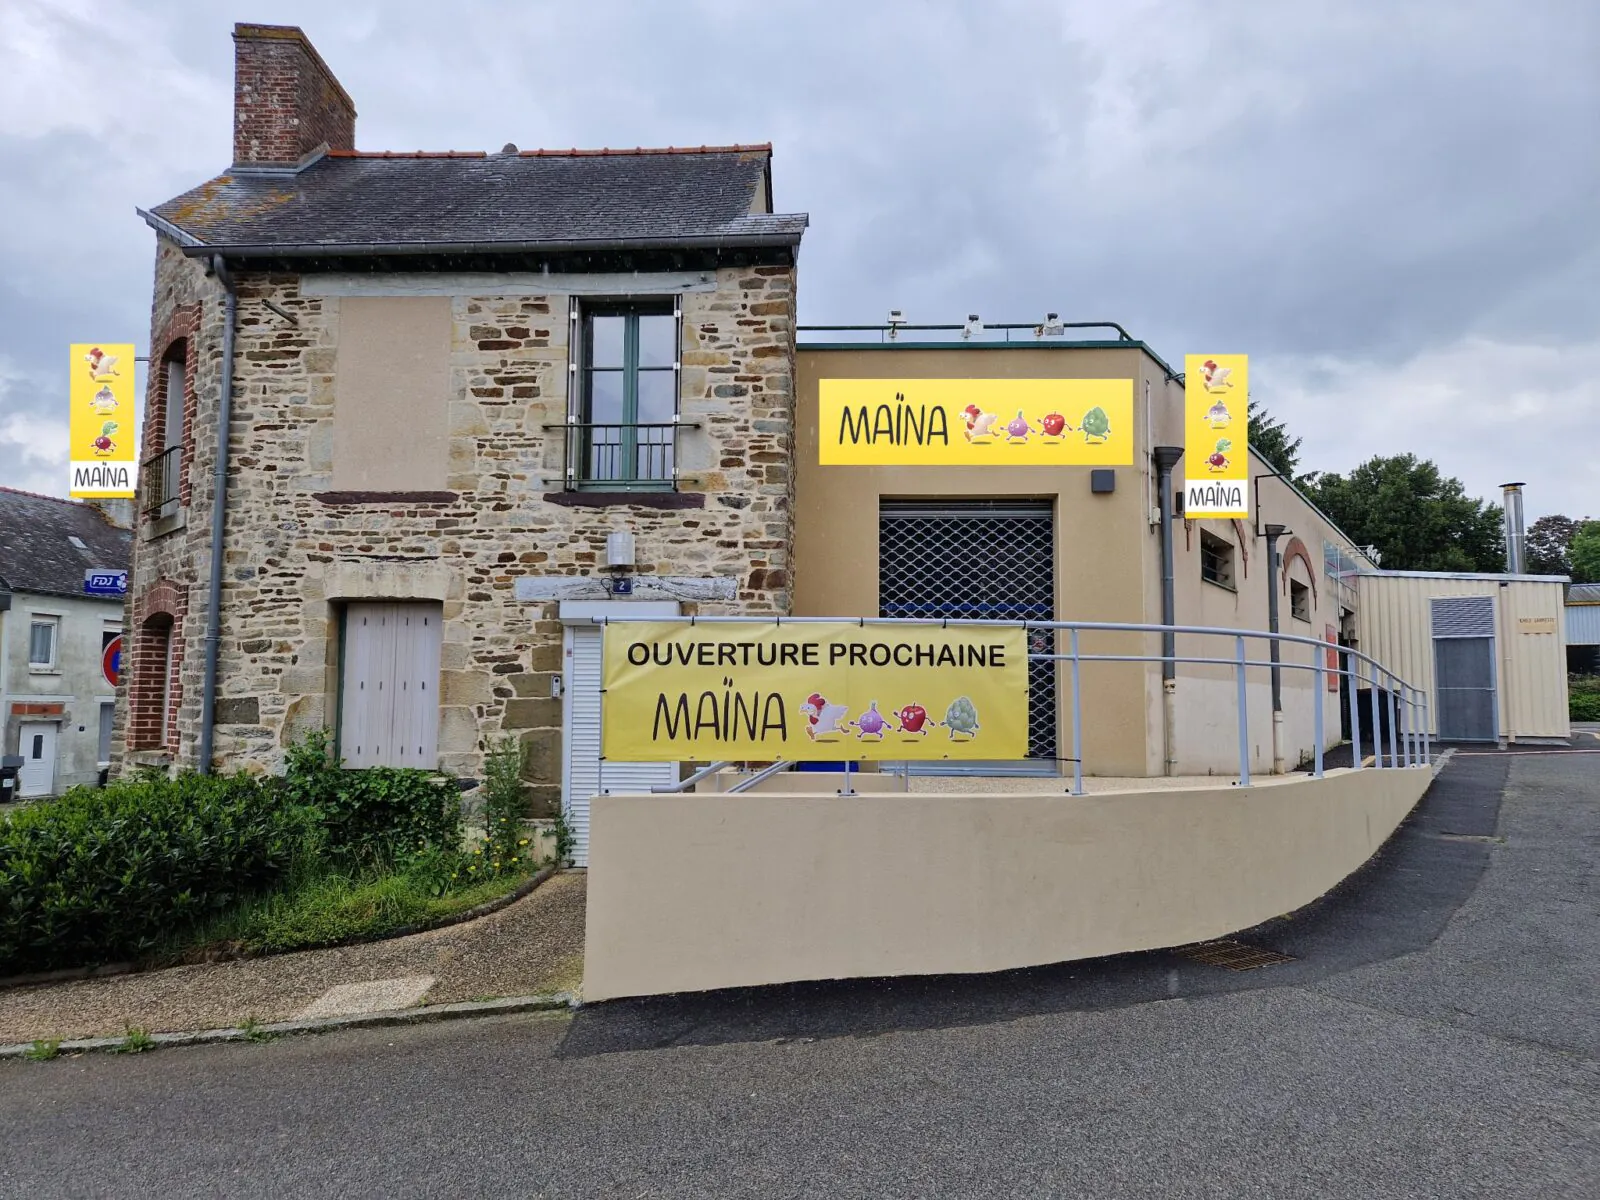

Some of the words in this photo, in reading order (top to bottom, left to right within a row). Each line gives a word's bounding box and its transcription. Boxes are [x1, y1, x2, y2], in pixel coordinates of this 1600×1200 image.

[839, 392, 949, 446] MAÏNA
[74, 461, 129, 487] MAÏNA
[1189, 481, 1242, 507] MAÏNA
[93, 576, 113, 586] FDJ
[619, 581, 625, 591] 2
[627, 642, 820, 666] OUVERTURE
[829, 643, 1006, 668] PROCHAINE
[652, 676, 787, 742] MAÏNA
